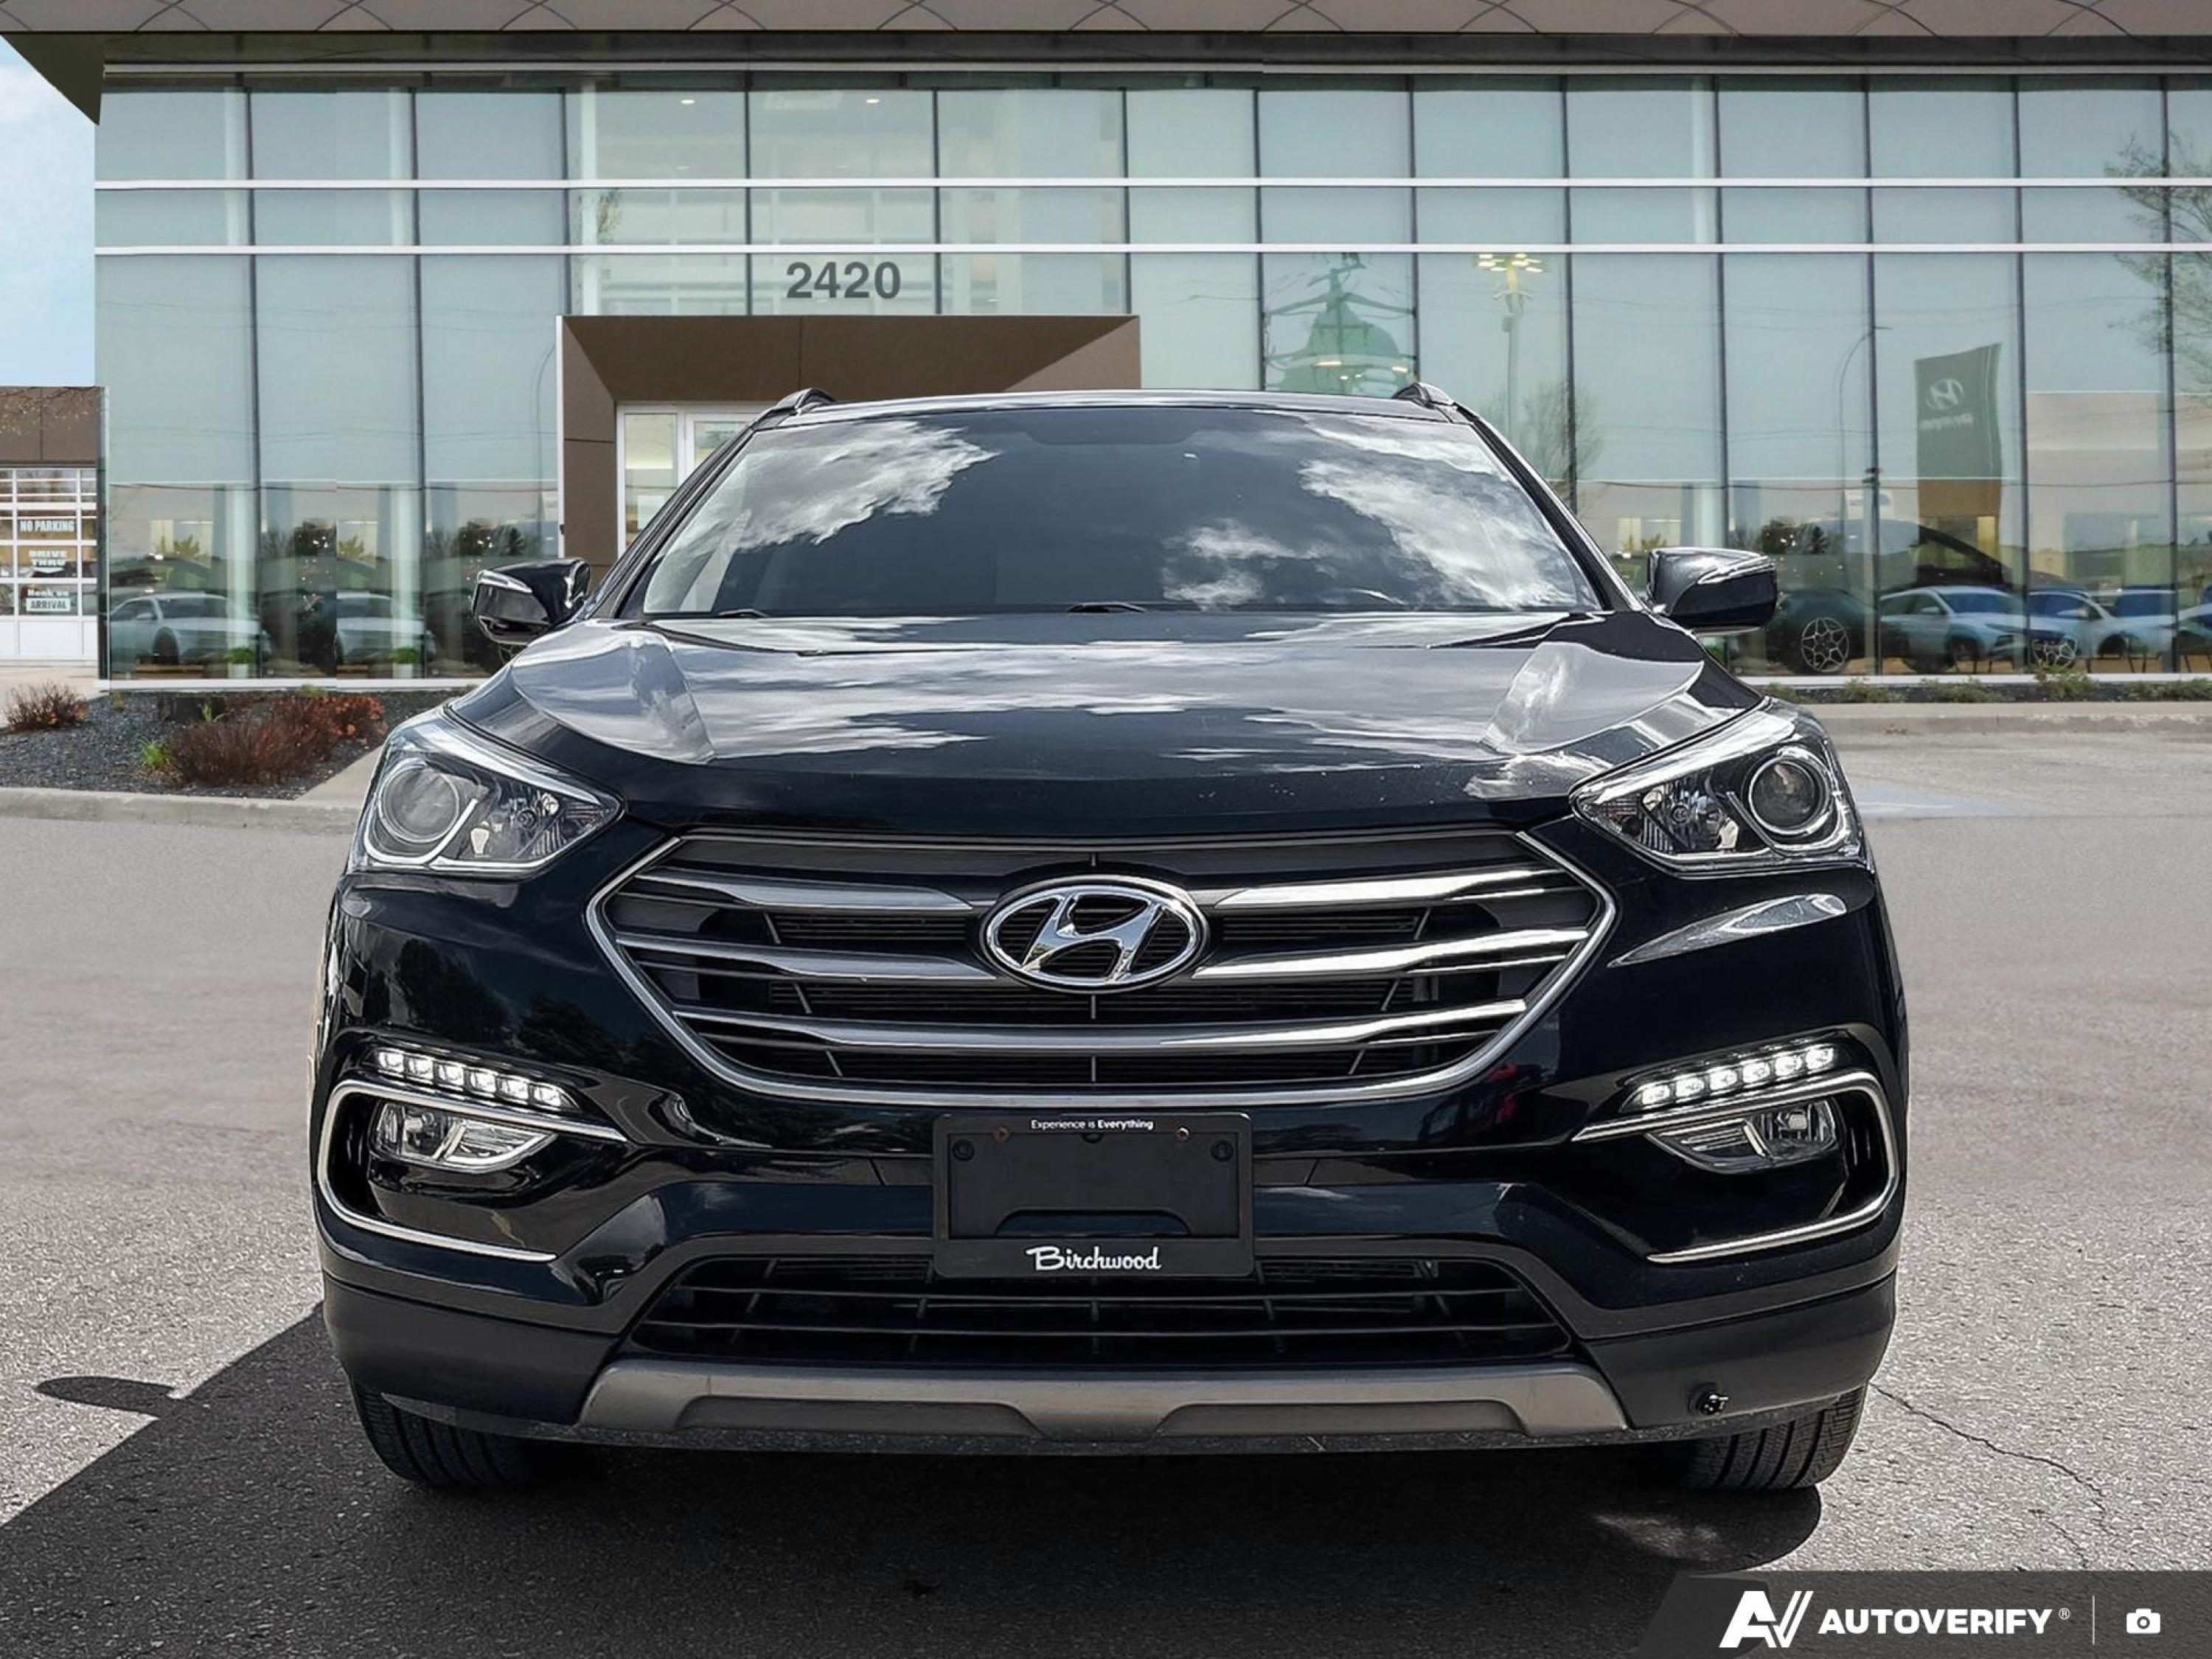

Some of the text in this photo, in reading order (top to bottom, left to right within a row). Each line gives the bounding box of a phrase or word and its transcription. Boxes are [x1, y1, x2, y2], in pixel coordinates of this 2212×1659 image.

[786, 261, 901, 299] 2420
[20, 520, 74, 532] NO PARKING
[29, 550, 67, 558] DRIVE
[32, 558, 66, 566] THRU
[30, 599, 67, 609] ARRIVAL
[1031, 1119, 1154, 1130] Experience is Everything
[1026, 1245, 1162, 1271] Birchwood
